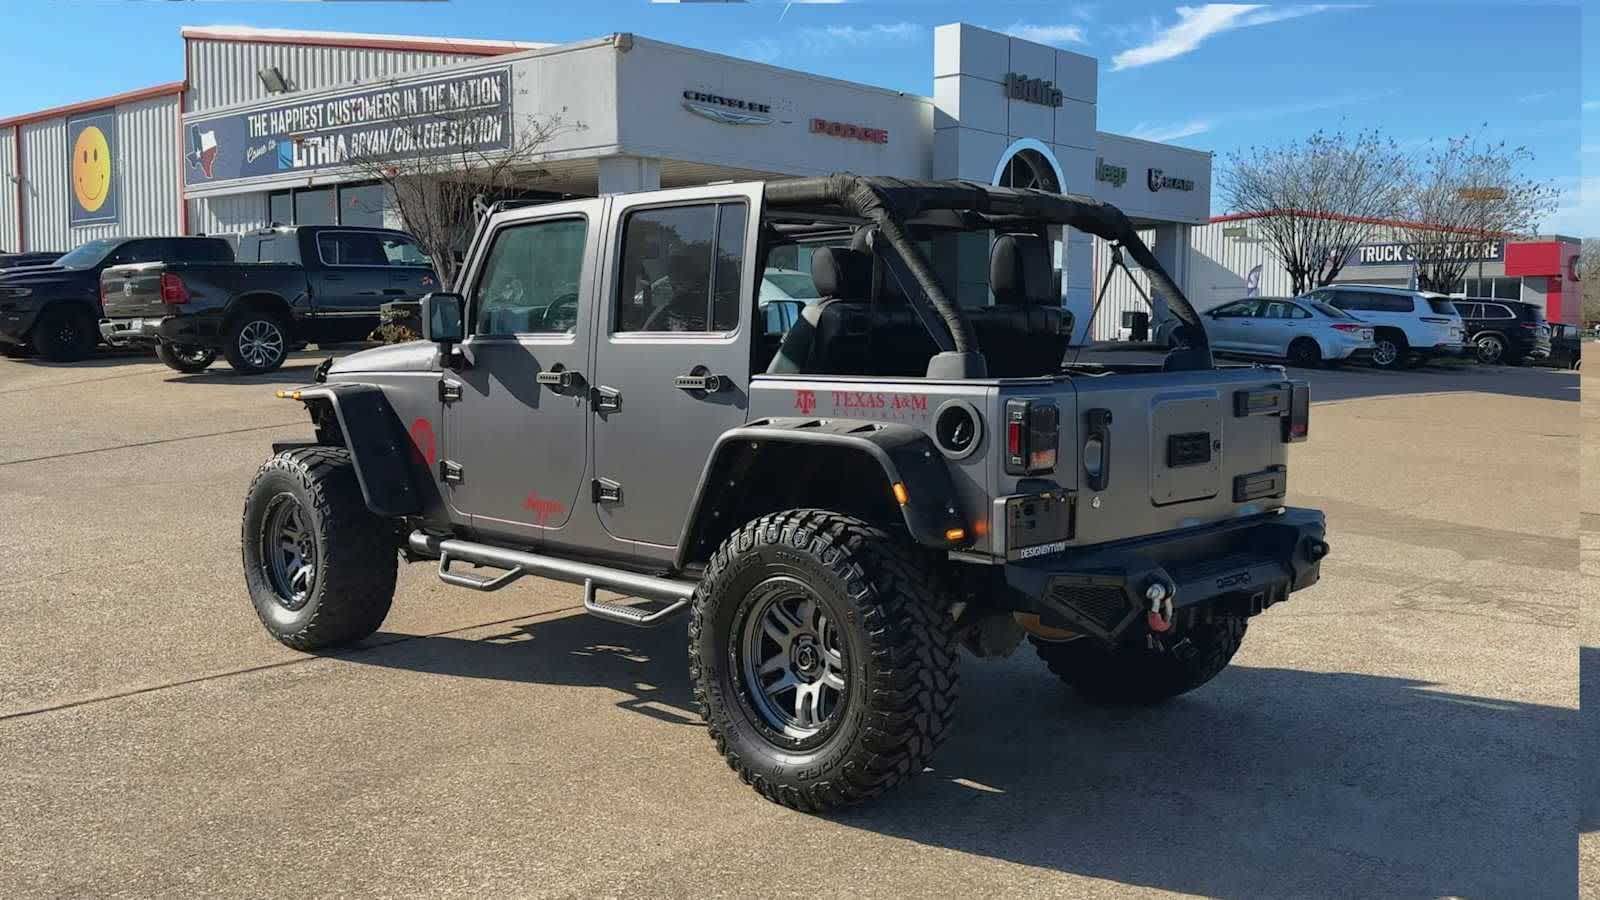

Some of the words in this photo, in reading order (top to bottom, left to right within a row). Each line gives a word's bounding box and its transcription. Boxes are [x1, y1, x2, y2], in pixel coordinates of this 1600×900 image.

[248, 112, 268, 138] THE
[270, 103, 324, 135] HAPPIEST
[327, 92, 400, 126] CUSTOMERS
[404, 88, 417, 113] IN
[421, 84, 446, 112] THE
[450, 75, 501, 107] NATION
[683, 89, 771, 114] CHRYSLER
[449, 114, 503, 146] STATION
[808, 118, 888, 144] DODGE
[1095, 156, 1127, 188] Jeep
[1359, 244, 1403, 262] TRUCK
[832, 391, 885, 409] TEXAS
[891, 393, 928, 410] A&M
